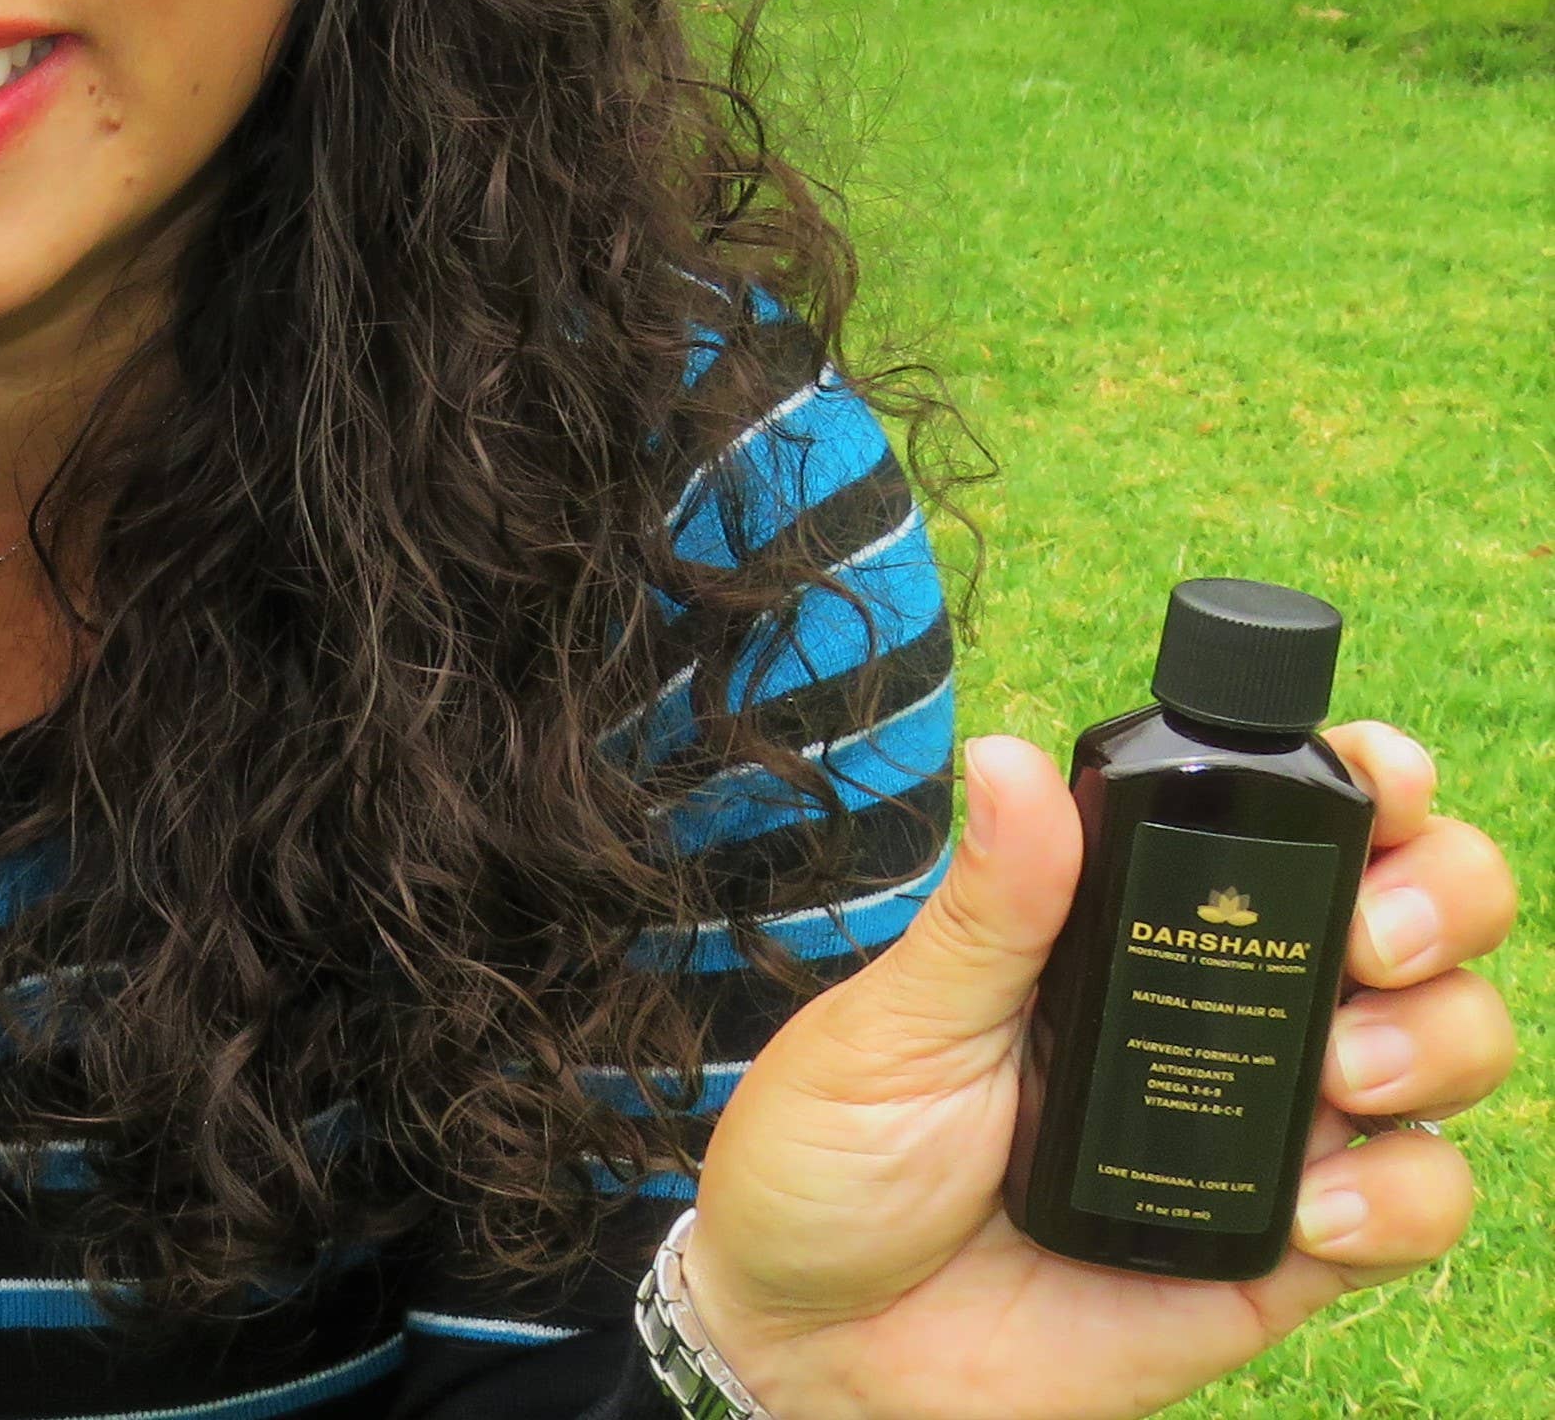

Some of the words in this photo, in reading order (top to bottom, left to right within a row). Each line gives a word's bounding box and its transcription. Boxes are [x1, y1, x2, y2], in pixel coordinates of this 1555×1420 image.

[1128, 945, 1187, 962] MOISTURIZE
[1200, 957, 1254, 970] CONDITION
[1266, 965, 1306, 973] SMOOTH
[1133, 991, 1189, 1008] NATURAL
[1192, 1000, 1234, 1013] INDIAN
[1237, 1006, 1265, 1016] HAIR
[1268, 1008, 1287, 1018] OIL
[1127, 1039, 1192, 1057] AYURVEDIC
[1195, 1049, 1249, 1063] FORMULA
[1253, 1055, 1275, 1065] with
[1150, 1063, 1234, 1081] ANTIOXIDANTS
[1147, 1079, 1188, 1093] OMEGA
[1145, 1096, 1198, 1112] VITAMINS
[1200, 1104, 1243, 1116] A-B-C-E
[1098, 1164, 1128, 1177] LOVE
[1199, 1181, 1228, 1191] LOVE
